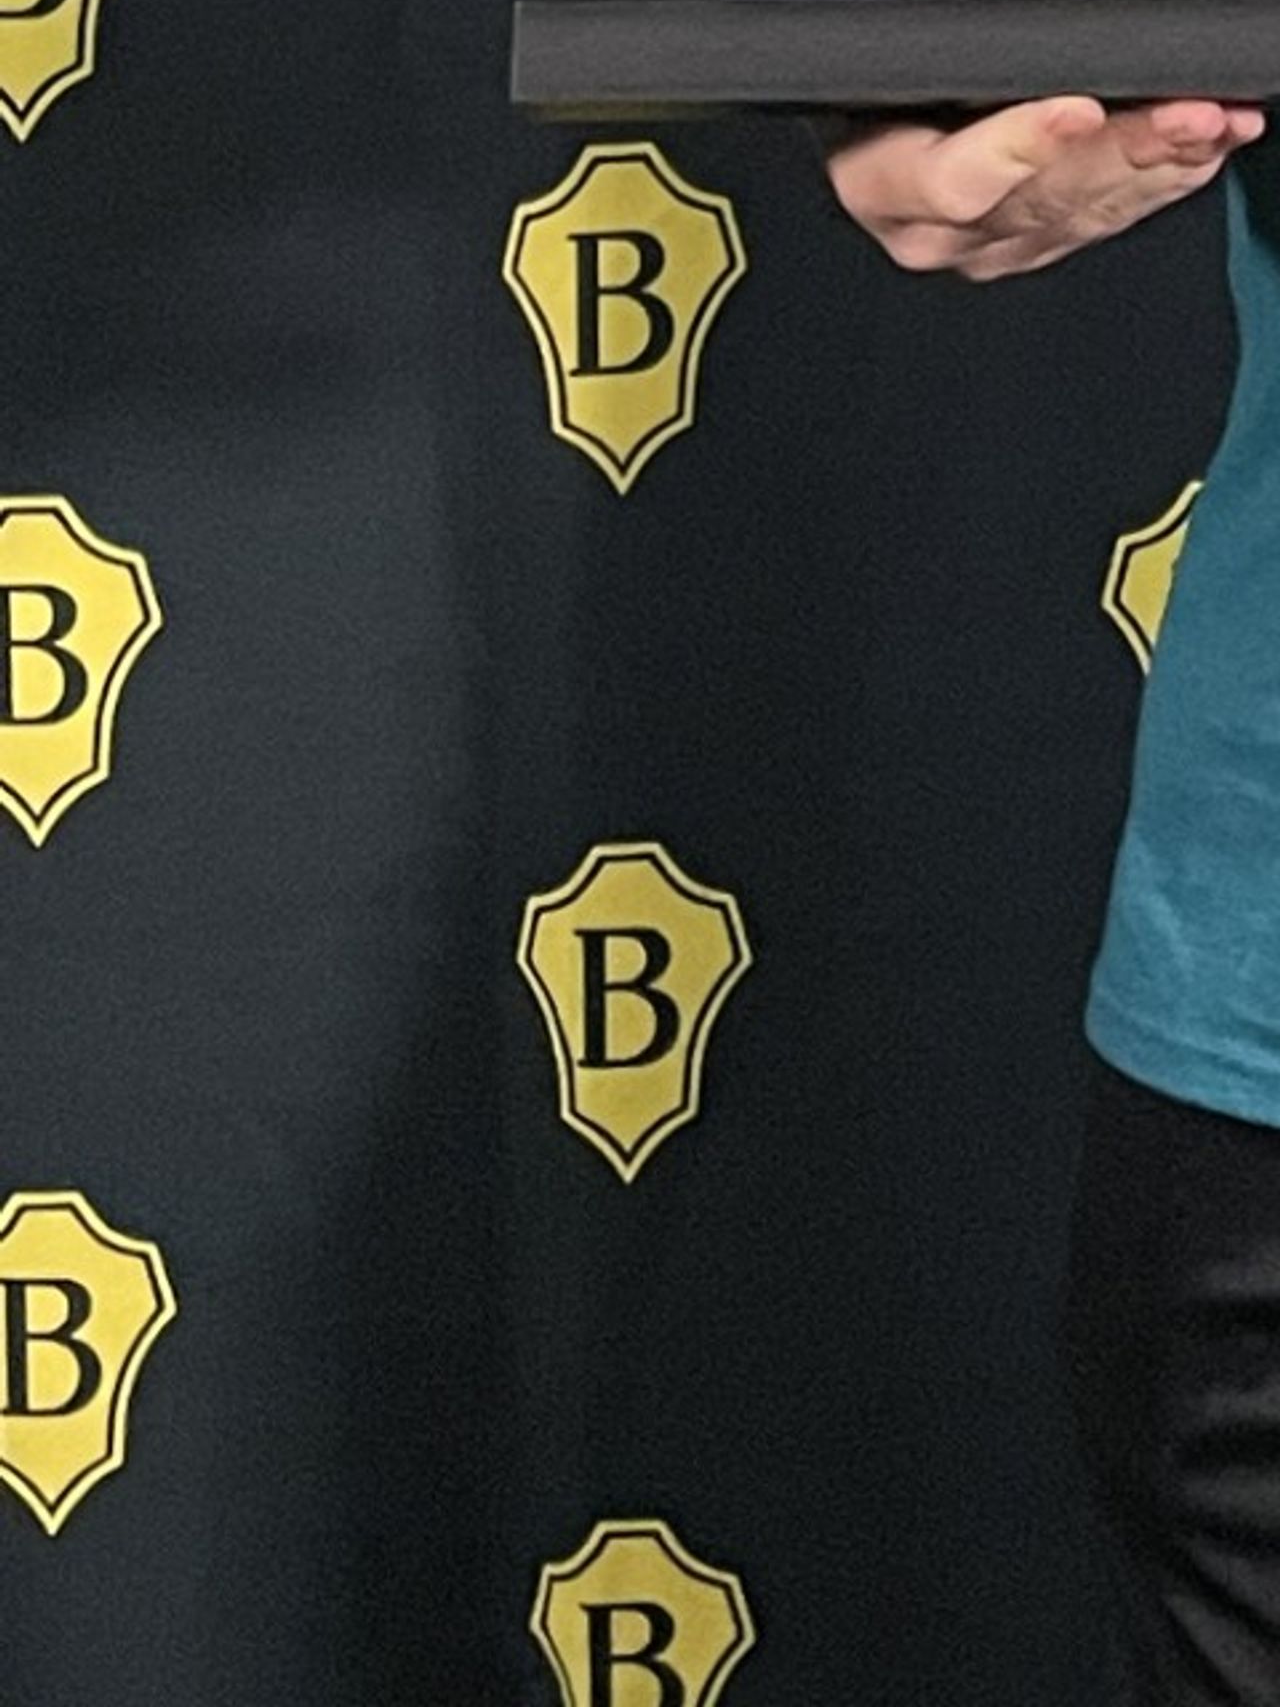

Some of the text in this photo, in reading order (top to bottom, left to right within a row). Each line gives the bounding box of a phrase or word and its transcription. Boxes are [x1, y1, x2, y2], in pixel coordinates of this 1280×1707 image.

[568, 230, 674, 376] B
[574, 927, 680, 1069] B
[0, 1279, 101, 1416] B
